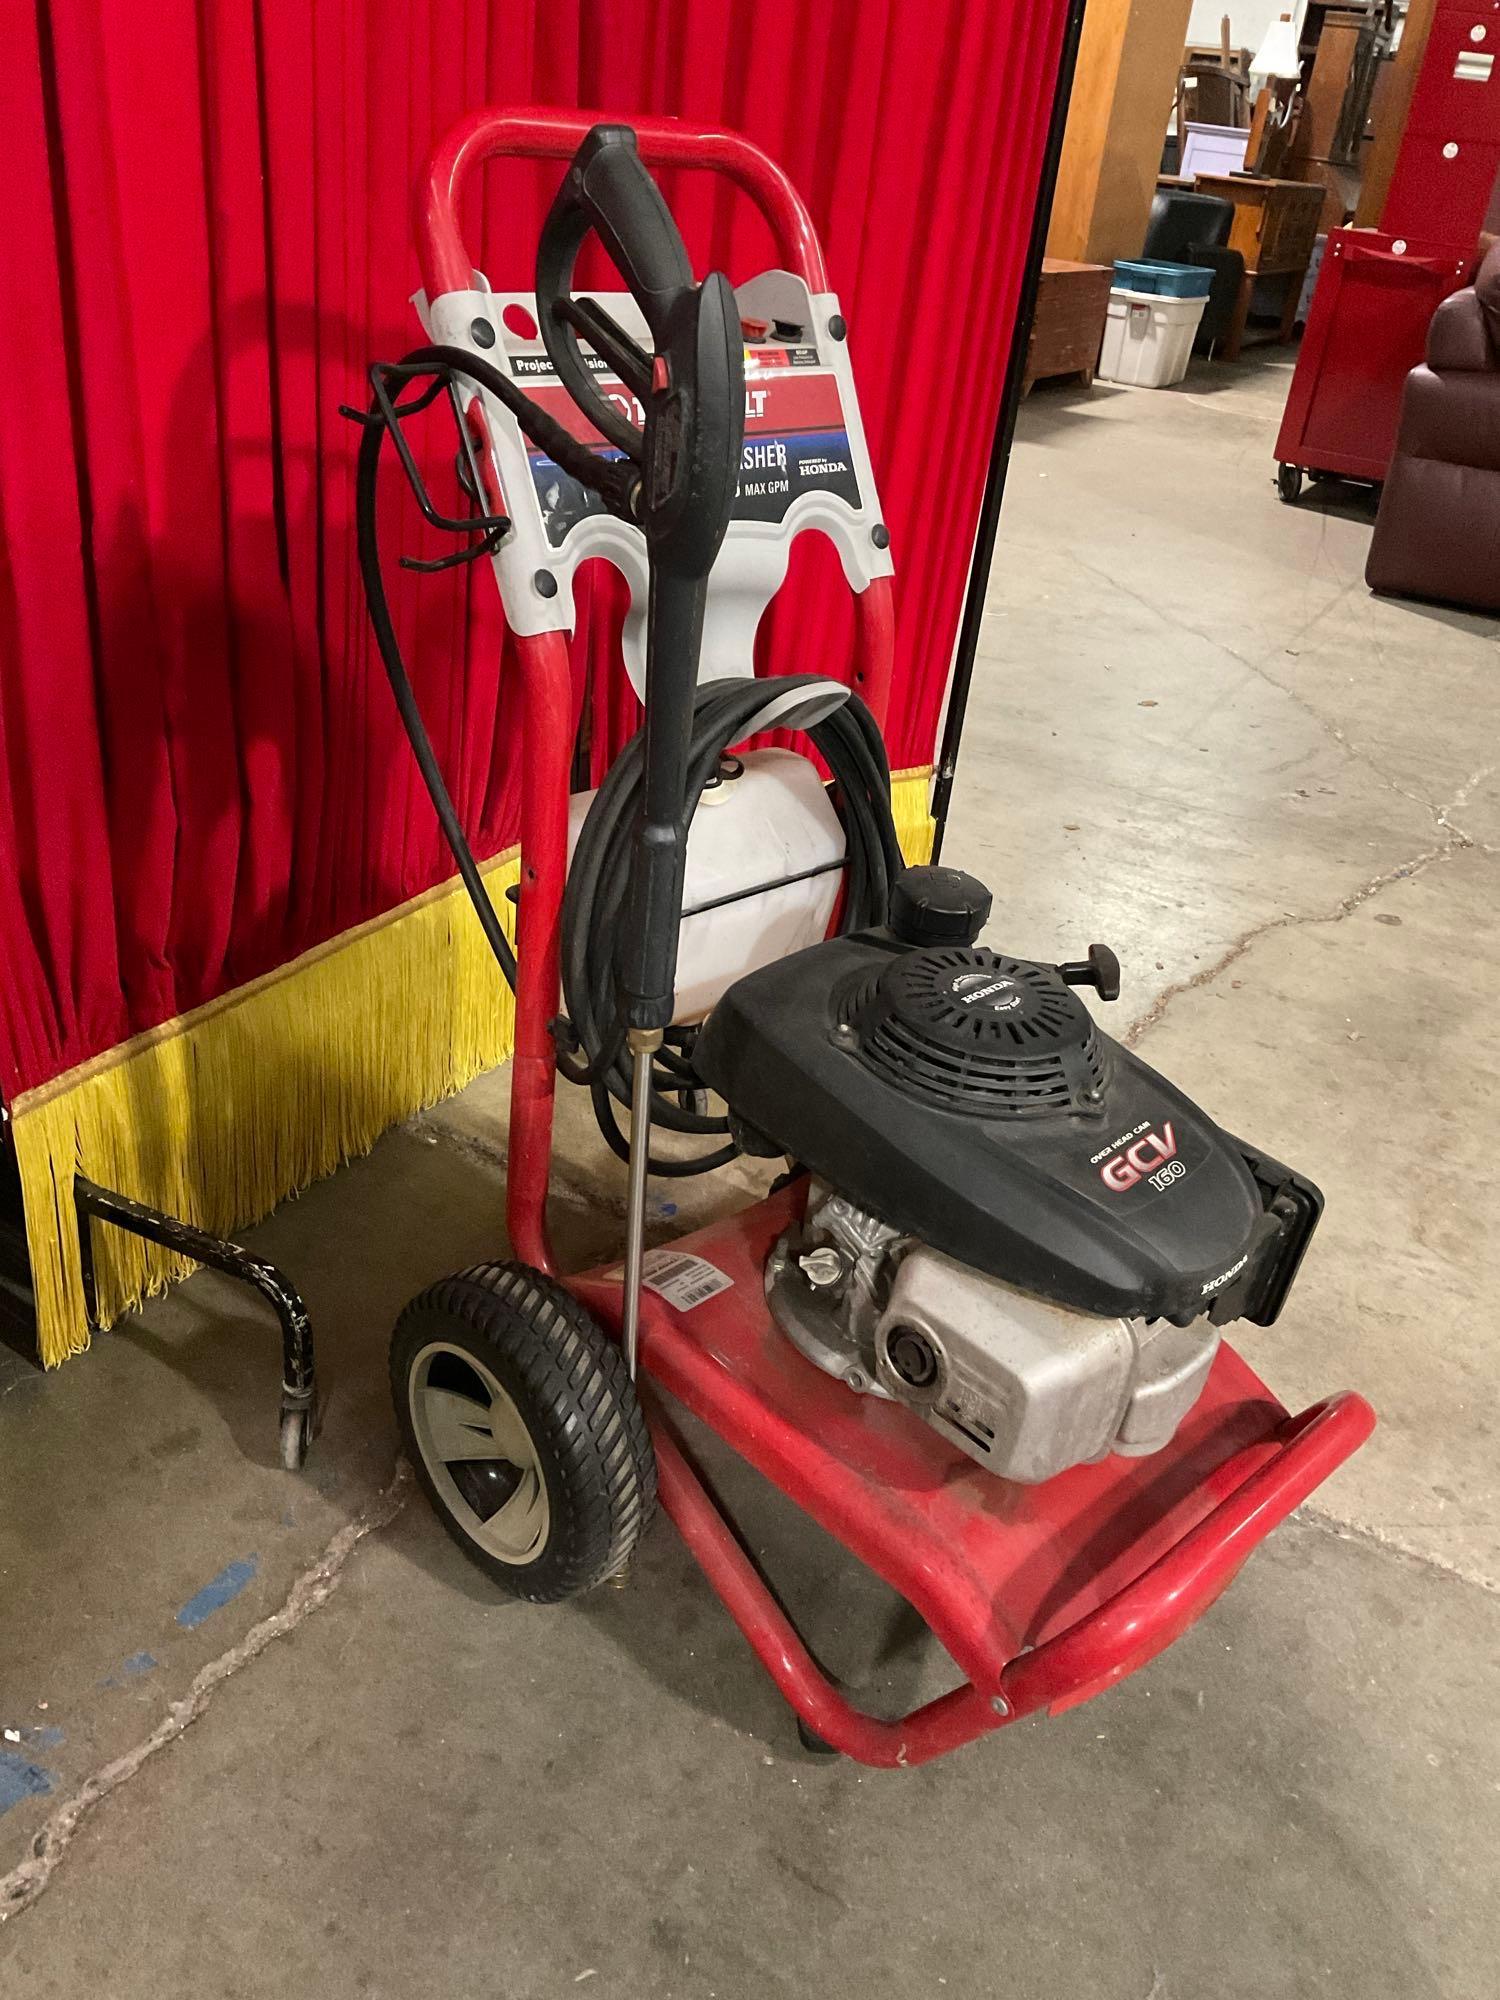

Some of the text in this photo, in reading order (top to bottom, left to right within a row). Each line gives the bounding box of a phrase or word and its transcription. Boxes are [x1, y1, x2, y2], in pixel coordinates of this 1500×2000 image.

[516, 359, 554, 373] Projec
[740, 444, 787, 470] SHER
[798, 461, 848, 476] HONDA
[744, 482, 766, 497] MAX
[767, 479, 789, 494] GPM
[960, 980, 1015, 1004] HONDA
[1090, 1120, 1151, 1164] OVER HEAD CAM
[1100, 1120, 1177, 1193] GCV
[1148, 1160, 1186, 1192] 160
